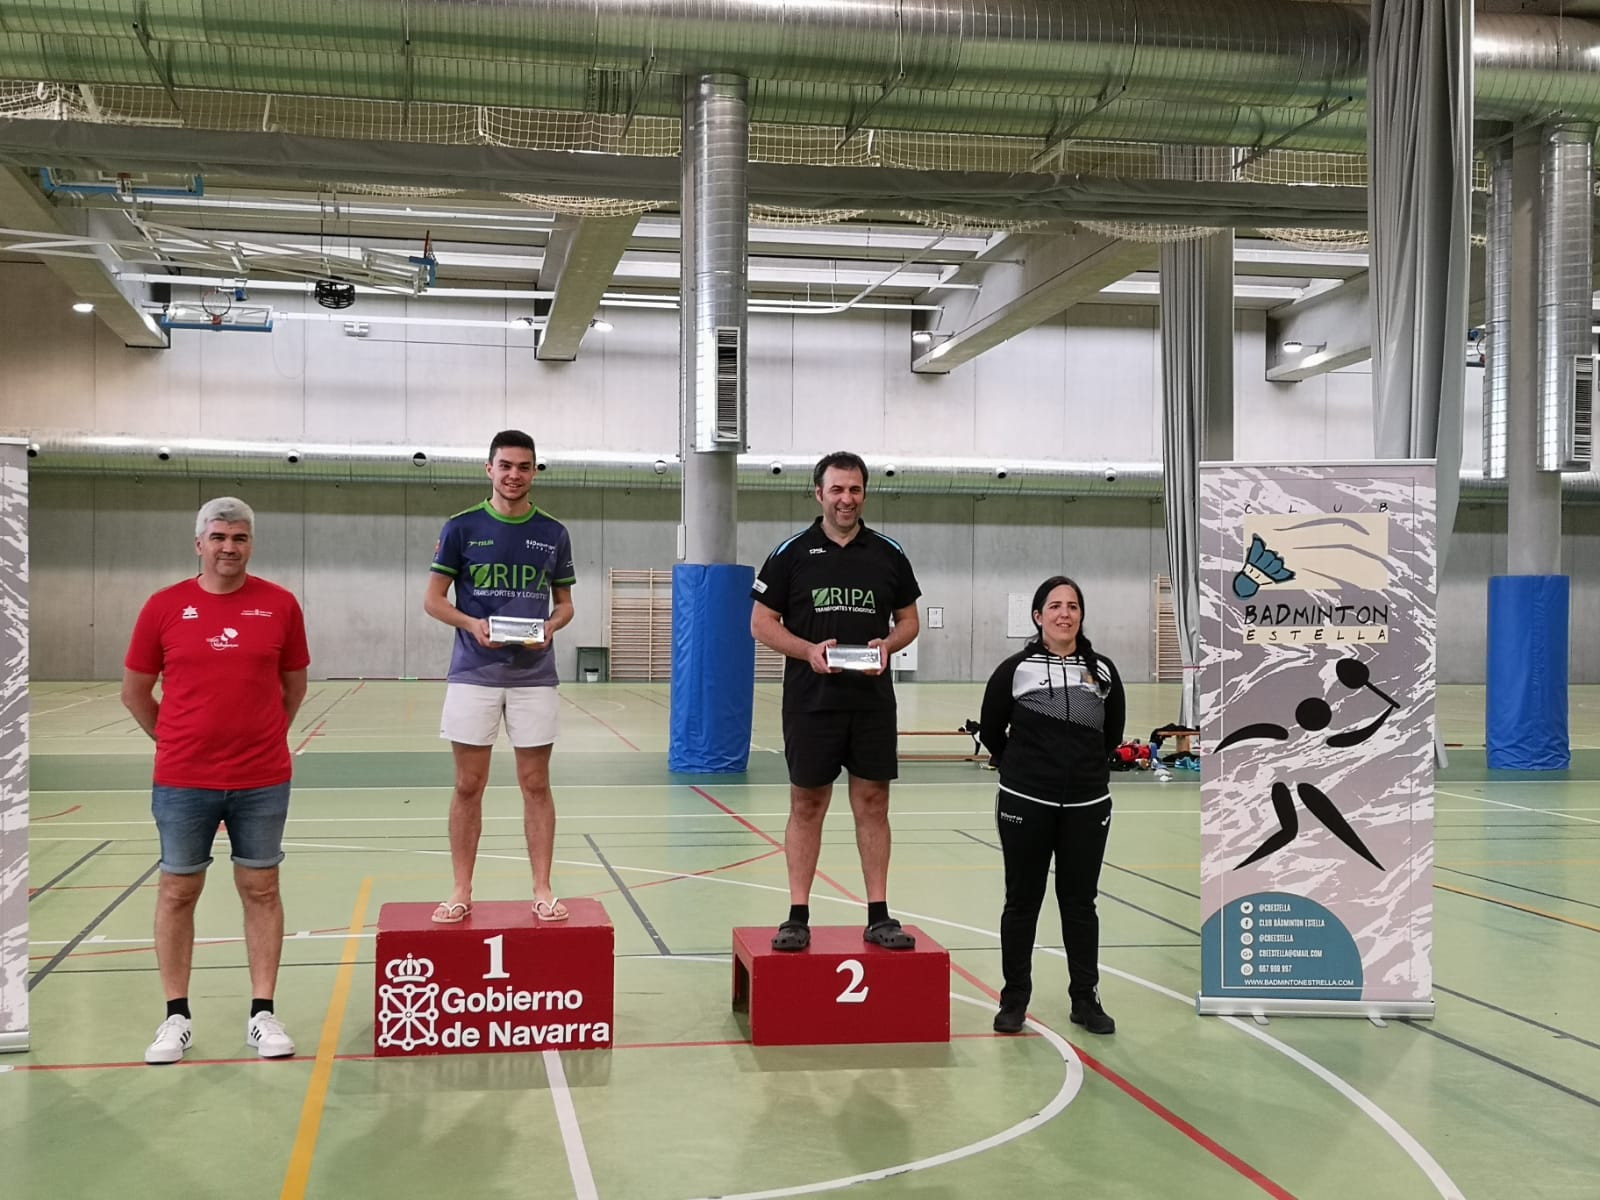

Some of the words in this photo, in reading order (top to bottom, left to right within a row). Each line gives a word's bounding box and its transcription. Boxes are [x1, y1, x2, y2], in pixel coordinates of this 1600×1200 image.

[1244, 502, 1389, 514] CLUB
[493, 563, 550, 591] RIPA
[473, 588, 516, 598] TRANSPORTES
[516, 590, 522, 598] Y
[830, 587, 876, 608] RIPA
[815, 605, 847, 613] TRANSPORTES
[1244, 603, 1389, 625] BADMINTON
[1246, 629, 1386, 641] ESTELLA
[1259, 919, 1273, 927] CLUB
[1305, 919, 1325, 927] ESTELLA
[482, 934, 511, 979] 1
[836, 959, 869, 1003] 2
[441, 986, 583, 1014] Gobierno
[441, 1022, 481, 1048] de
[488, 1021, 610, 1047] Navarra
